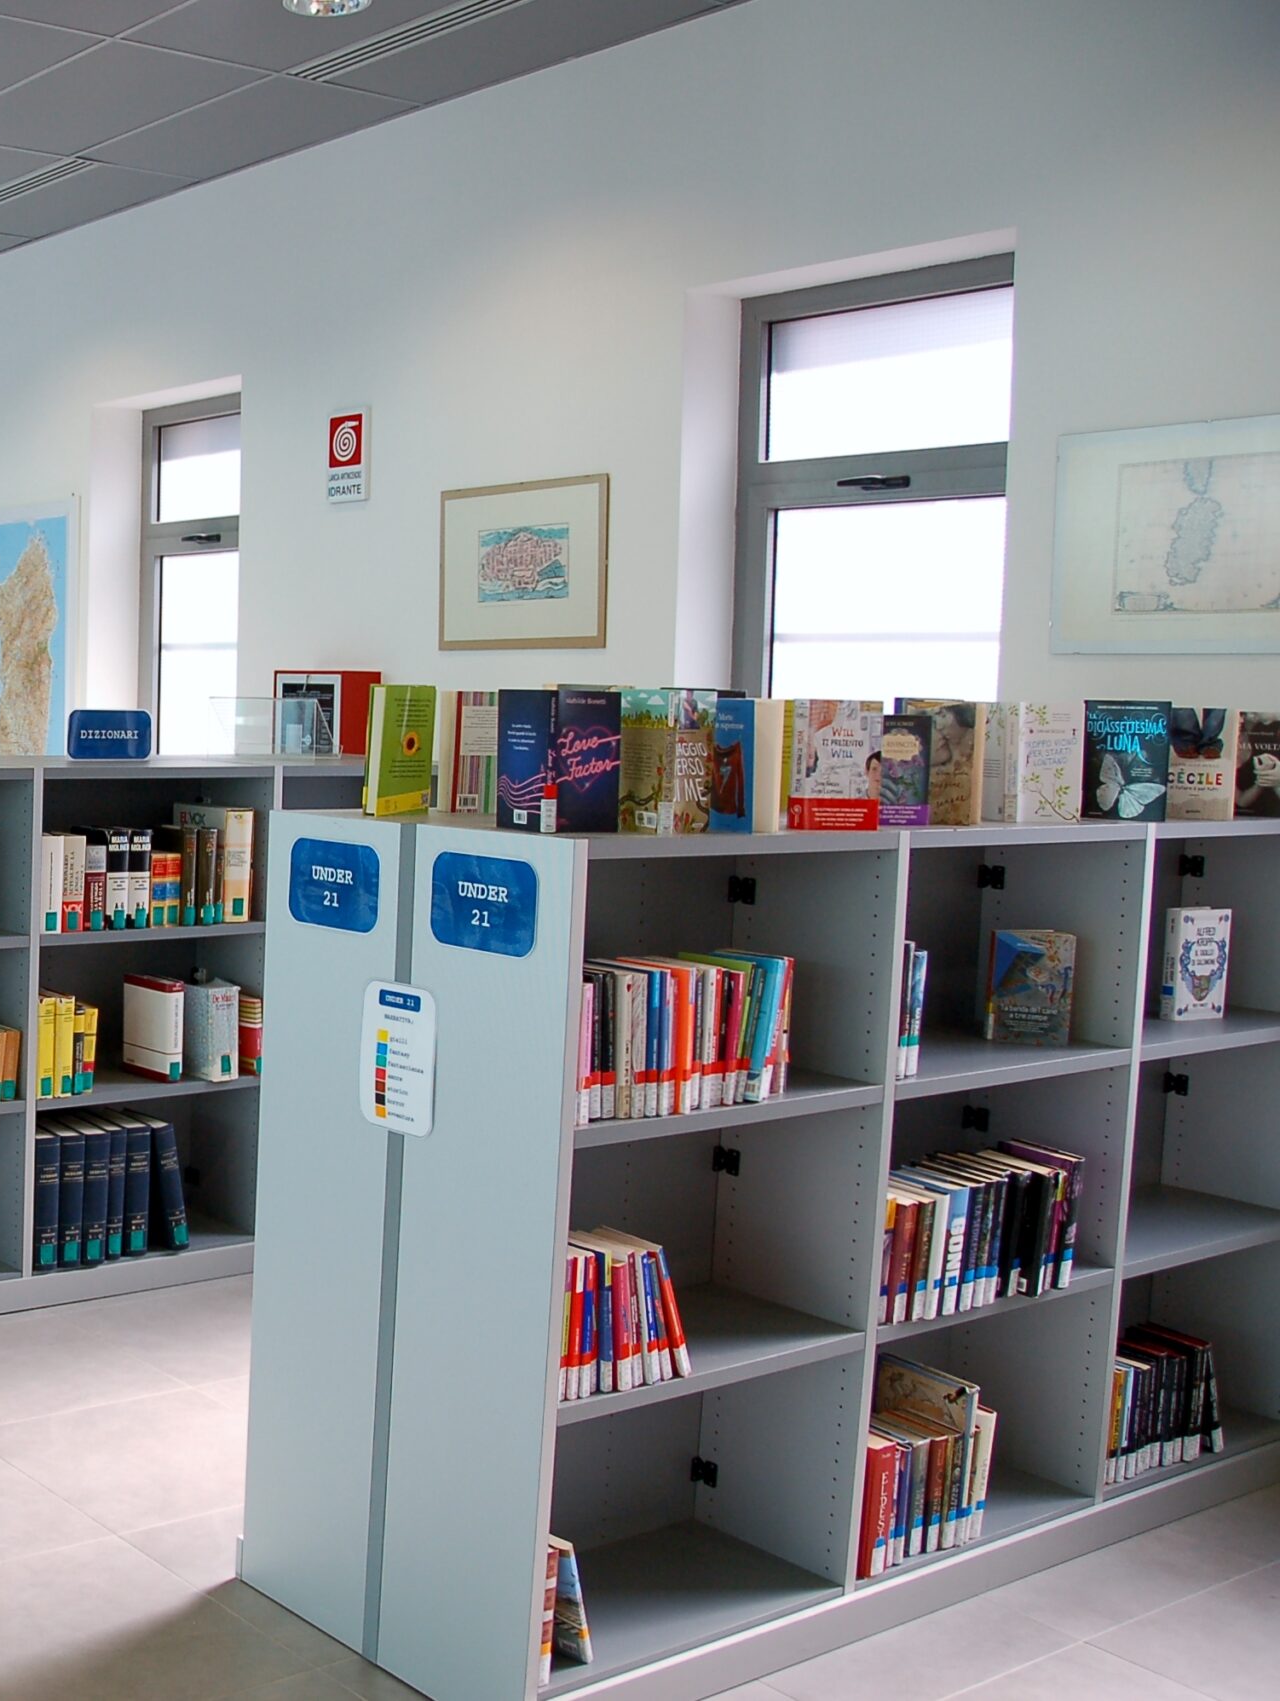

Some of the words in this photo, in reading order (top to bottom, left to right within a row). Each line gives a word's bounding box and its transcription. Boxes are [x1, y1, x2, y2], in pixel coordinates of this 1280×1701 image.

[328, 484, 362, 497] IDRANTE
[80, 730, 139, 740] DIZIONARI
[558, 731, 610, 757] Love
[1107, 734, 1141, 754] LUNA
[562, 755, 616, 781] Factor
[1167, 768, 1223, 786] CÉCILE
[684, 777, 708, 801] ME
[311, 865, 354, 885] UNDER
[323, 891, 339, 908] 21
[457, 881, 509, 903] UNDER
[471, 909, 491, 928] 21
[406, 998, 415, 1007] 21
[389, 1048, 410, 1060] fantasy
